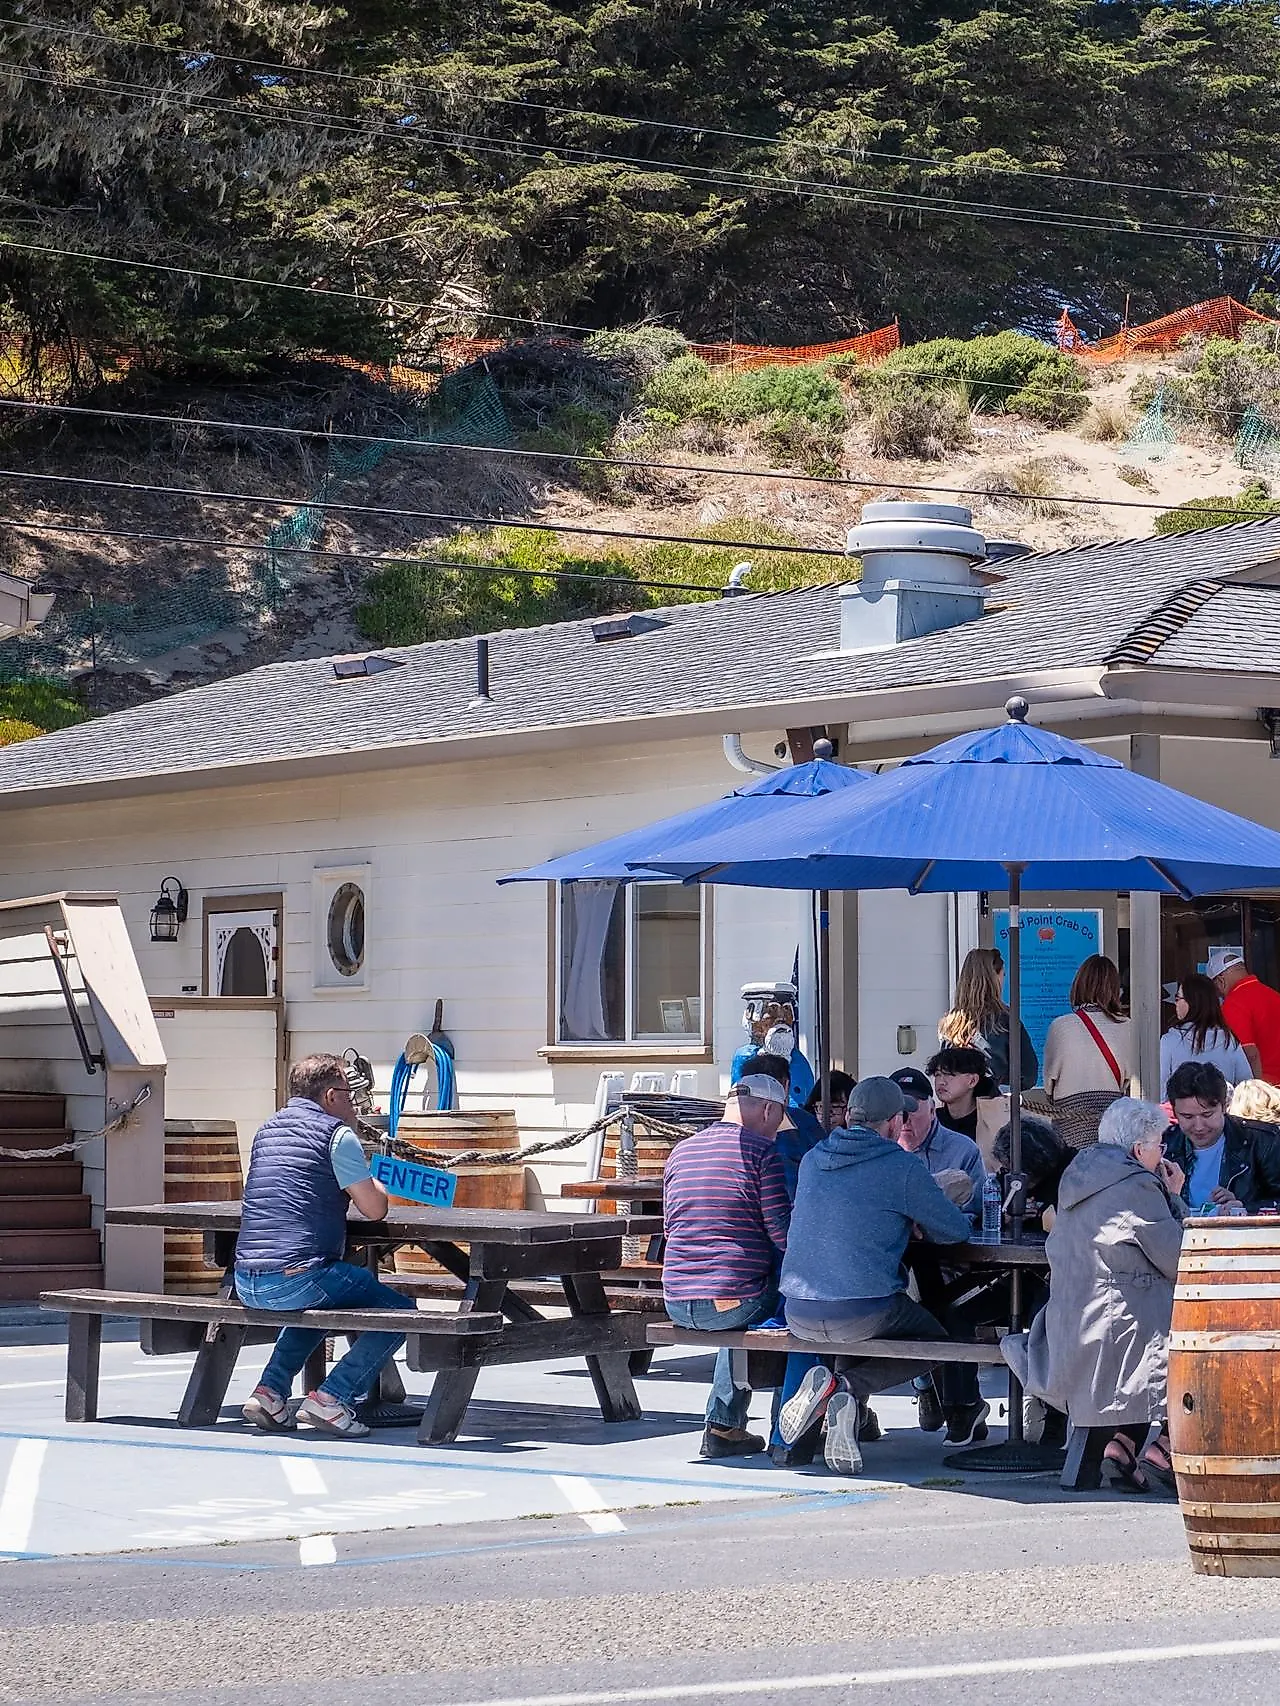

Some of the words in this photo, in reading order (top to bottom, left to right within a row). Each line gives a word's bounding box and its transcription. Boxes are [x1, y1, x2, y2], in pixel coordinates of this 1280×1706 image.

[1000, 918, 1025, 940] Sd
[1027, 914, 1053, 927] Point
[1055, 914, 1080, 932] Crab
[1081, 926, 1095, 940] Co
[377, 1161, 449, 1201] ENTER
